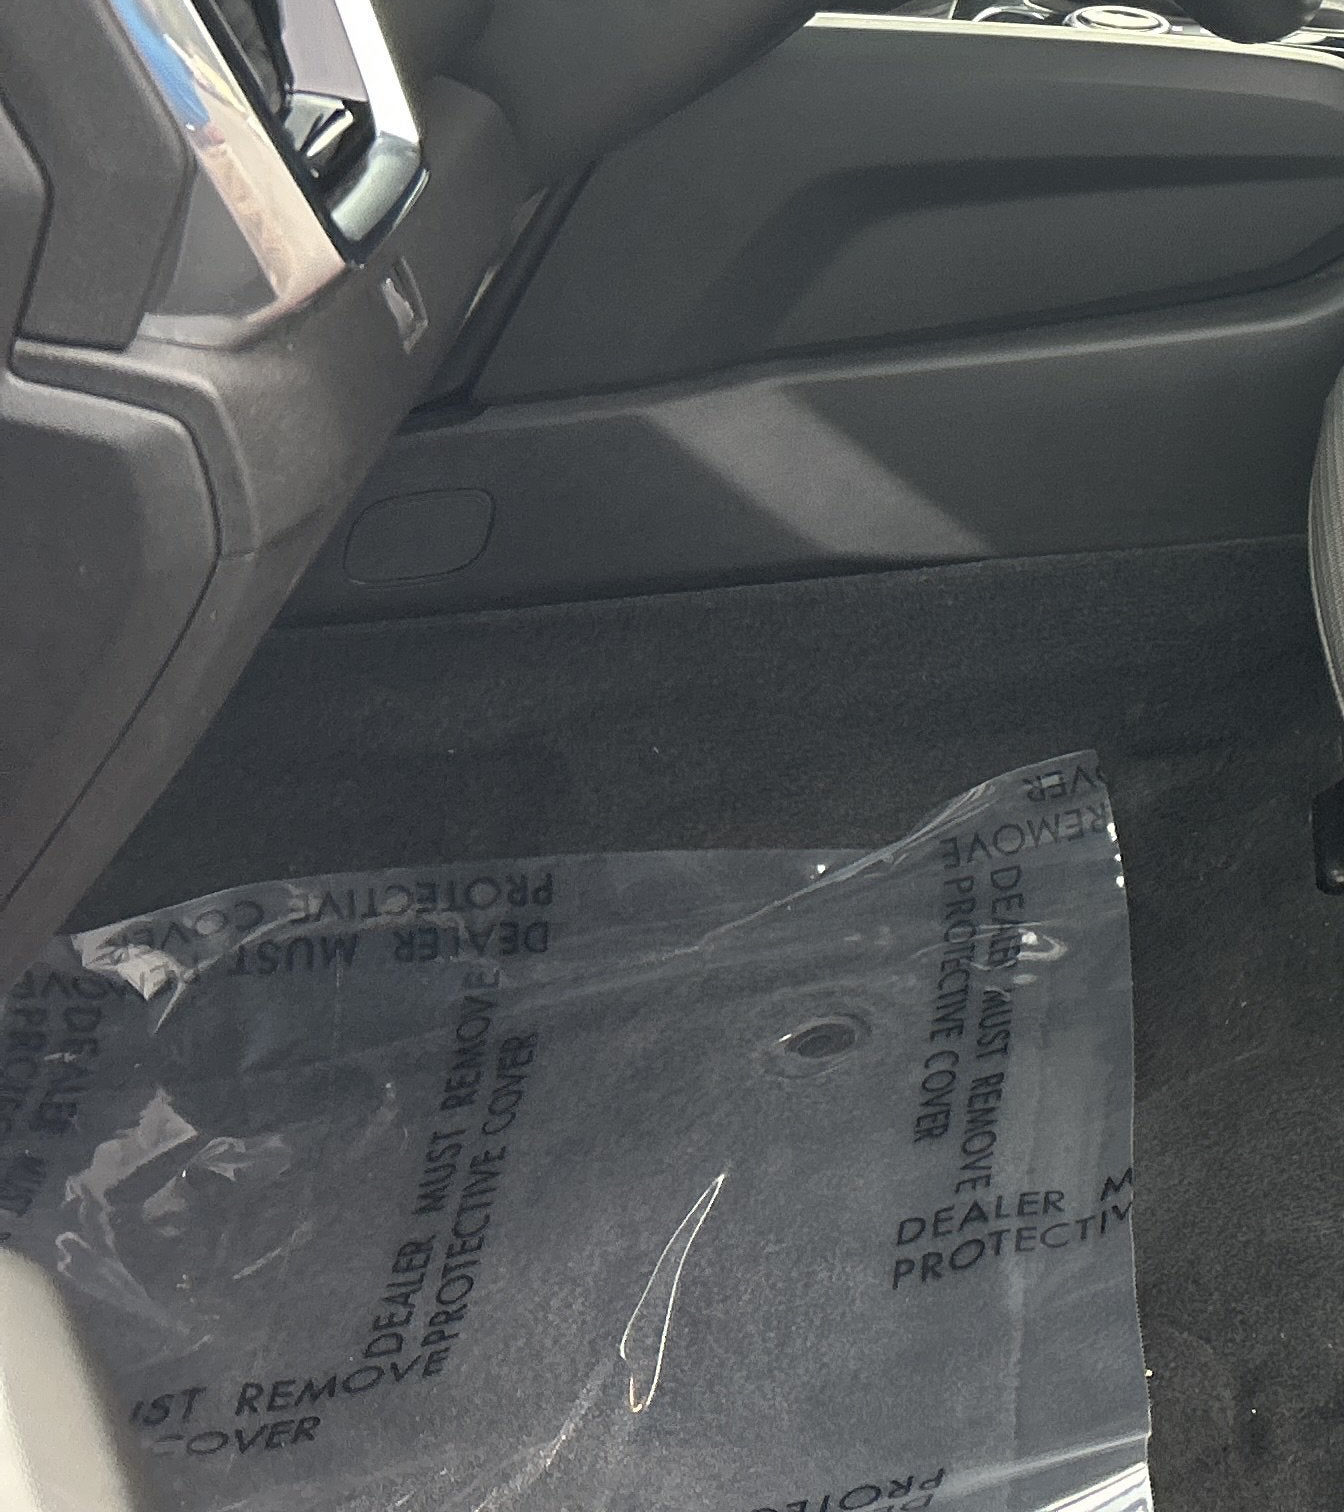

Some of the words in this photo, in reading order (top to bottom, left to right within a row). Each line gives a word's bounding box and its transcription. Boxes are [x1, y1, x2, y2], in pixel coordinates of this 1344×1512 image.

[938, 803, 1108, 869] REMOVE
[286, 873, 554, 925] PROTECTIVE
[393, 922, 549, 963] DEALER
[988, 865, 1023, 969] DEALER
[232, 934, 358, 977] MUST
[929, 876, 976, 1041] PROTECTIVE
[439, 968, 502, 1111] REMOVE
[976, 988, 1012, 1059] MUST
[913, 1051, 959, 1143] COVER
[955, 1072, 1004, 1194] REMOVE
[412, 1128, 467, 1216] MUST
[420, 1146, 507, 1347] PROTECTIVE
[481, 1033, 540, 1136] COVER
[896, 1190, 1065, 1247] DEALER
[362, 1236, 437, 1358] DEALER
[130, 1386, 206, 1426] ST
[235, 1346, 453, 1417] REMOVE
